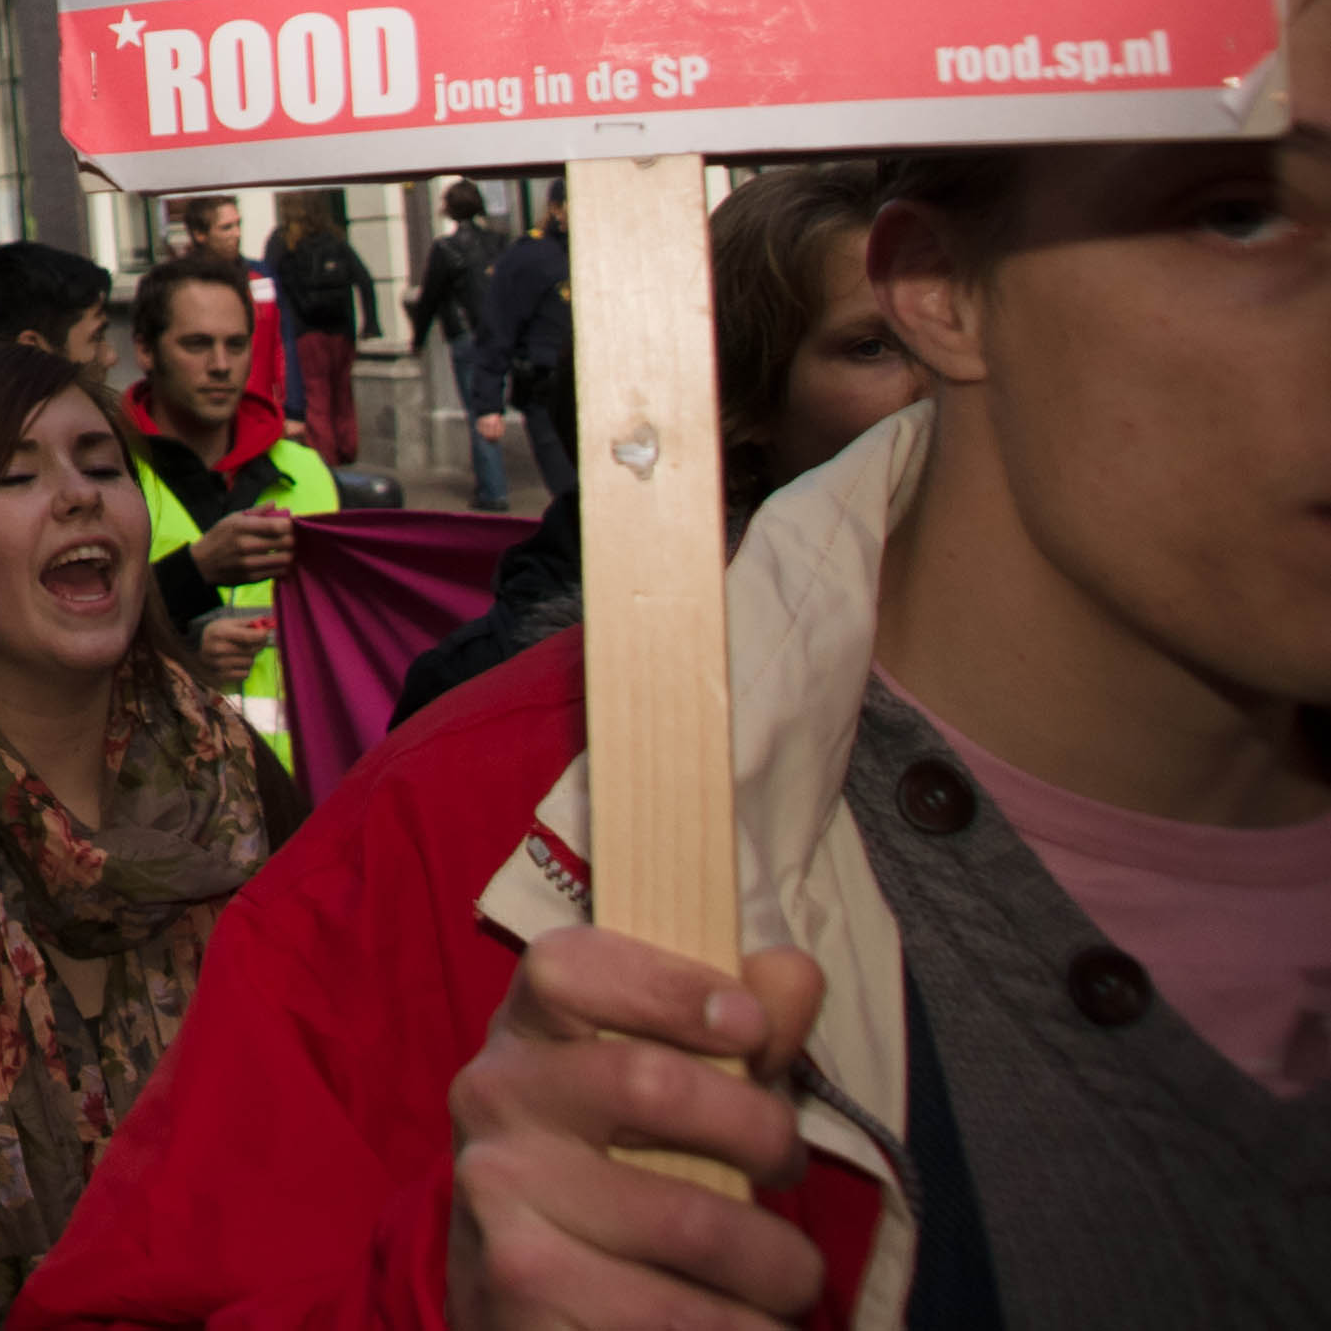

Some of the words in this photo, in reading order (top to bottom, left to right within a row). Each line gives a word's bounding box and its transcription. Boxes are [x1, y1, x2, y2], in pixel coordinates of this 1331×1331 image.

[144, 7, 419, 136] ROOD
[434, 73, 524, 121] jong
[534, 66, 573, 106] in
[586, 60, 638, 102] de
[651, 55, 710, 98] SP
[936, 28, 1172, 83] rood.sp.nl
